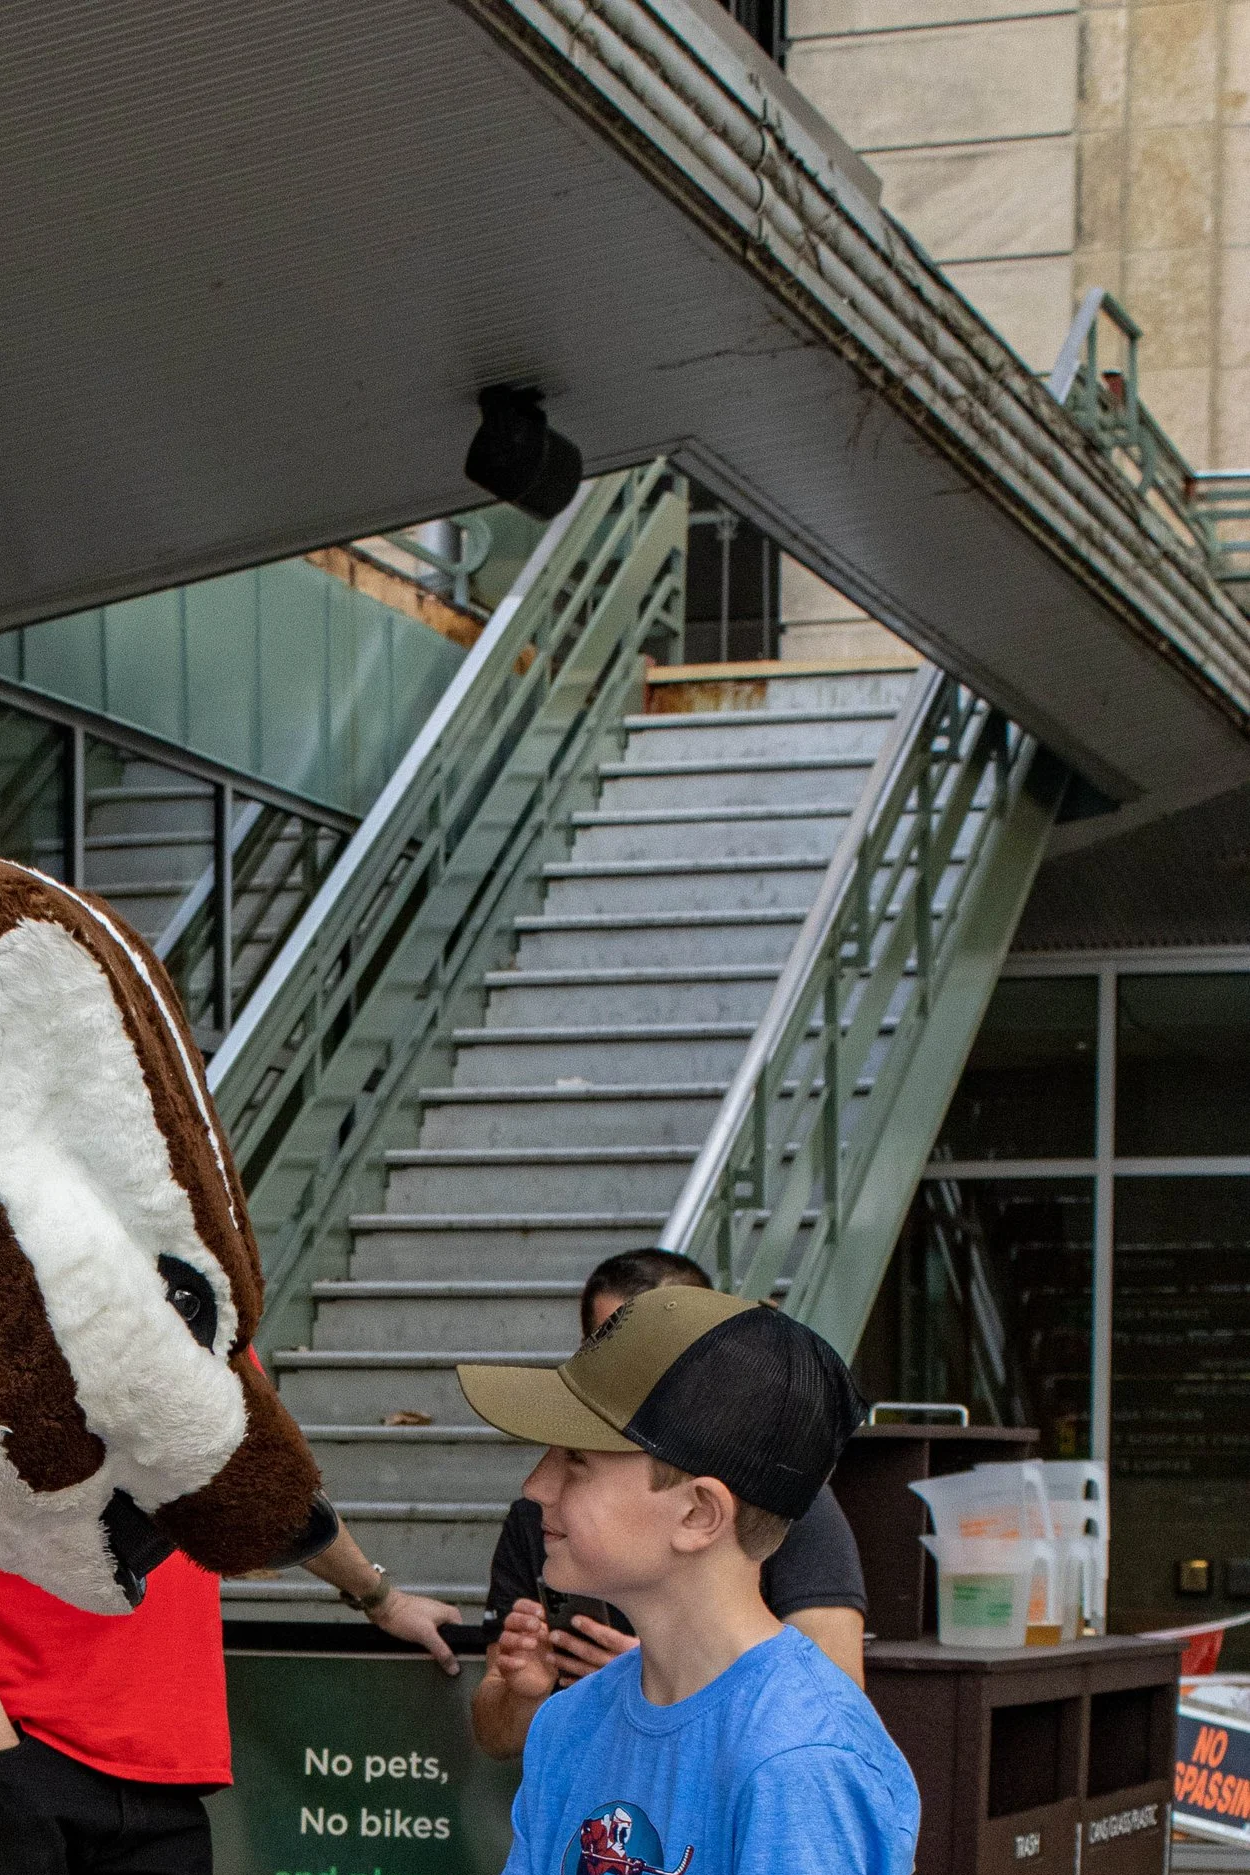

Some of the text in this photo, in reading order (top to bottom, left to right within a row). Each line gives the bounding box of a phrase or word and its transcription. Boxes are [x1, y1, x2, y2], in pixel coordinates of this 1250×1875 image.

[304, 1747, 449, 1784] No pets,
[1191, 1726, 1229, 1769] NO
[300, 1806, 451, 1840] No bikes
